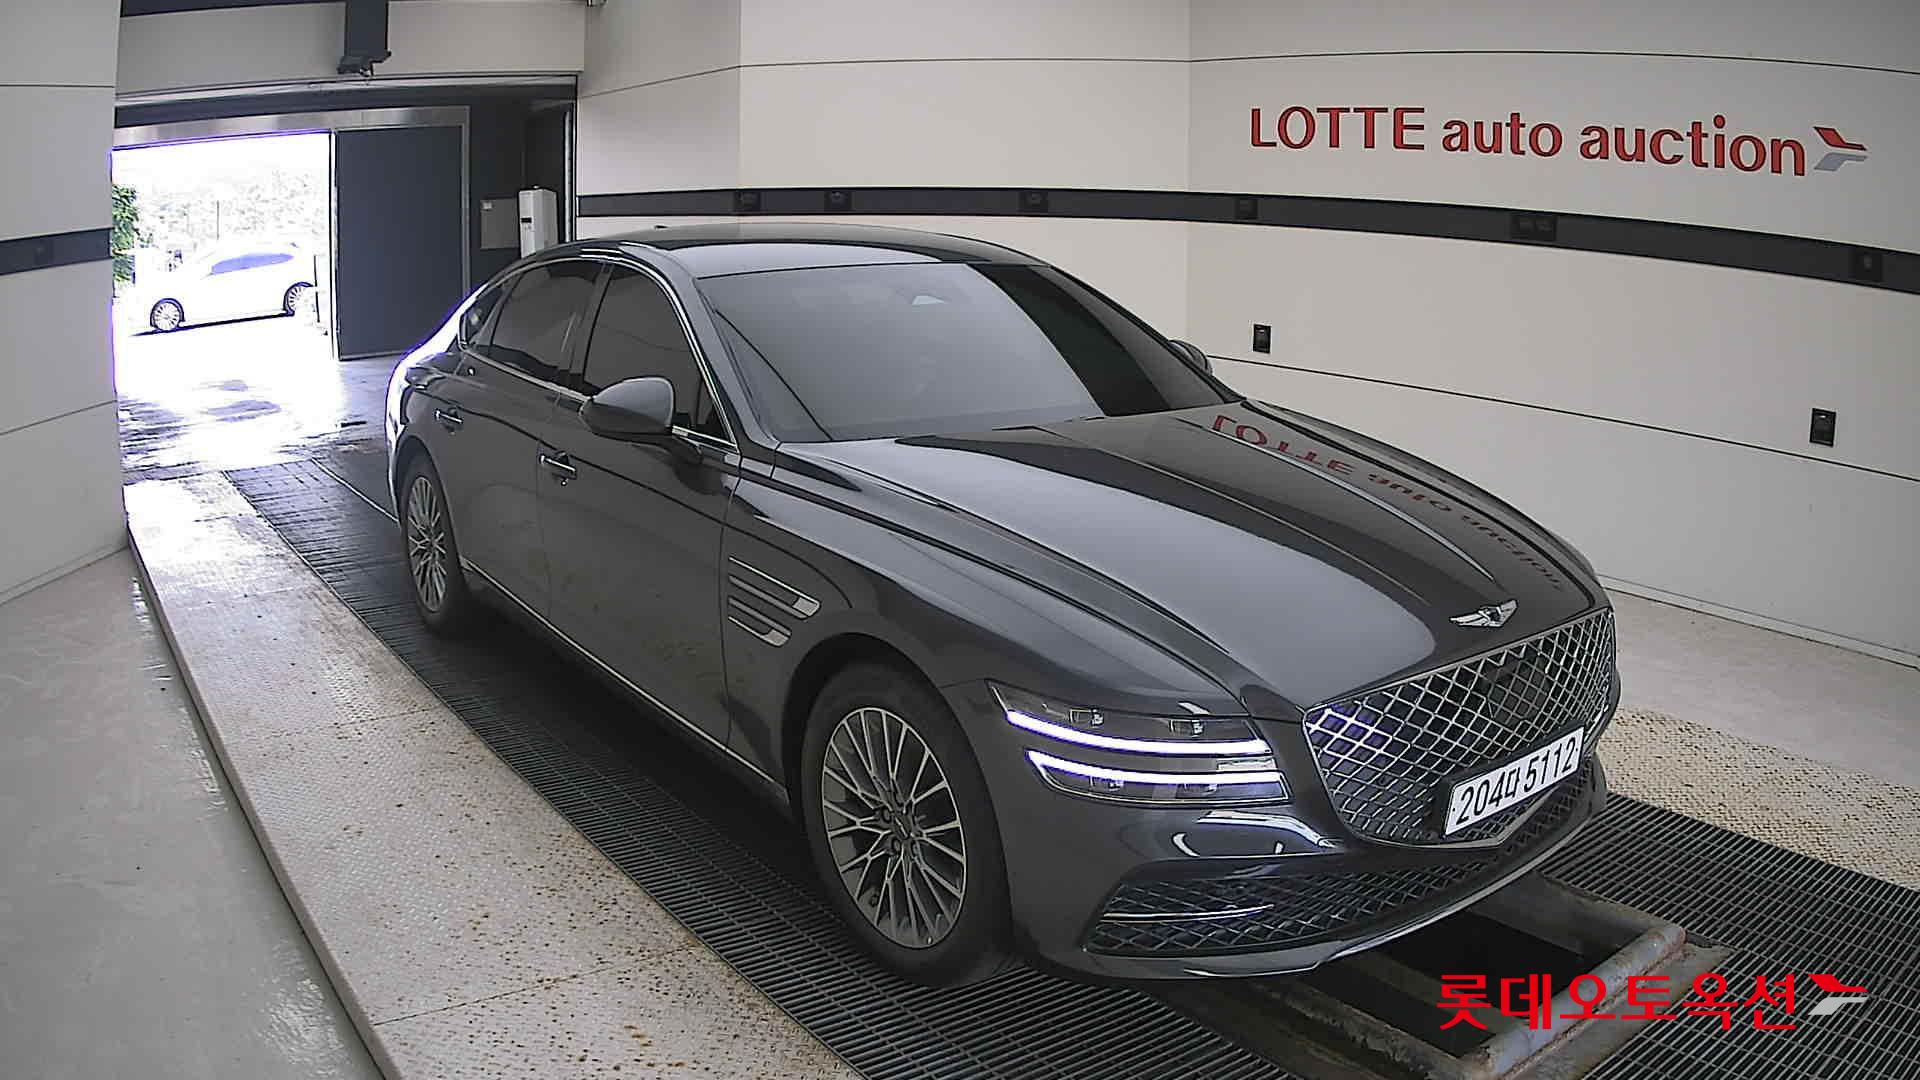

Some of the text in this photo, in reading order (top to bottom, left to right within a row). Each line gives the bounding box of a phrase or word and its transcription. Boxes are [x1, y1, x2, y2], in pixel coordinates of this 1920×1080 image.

[1250, 105, 1806, 176] LOTTE auto auction
[1524, 737, 1577, 793] 5112
